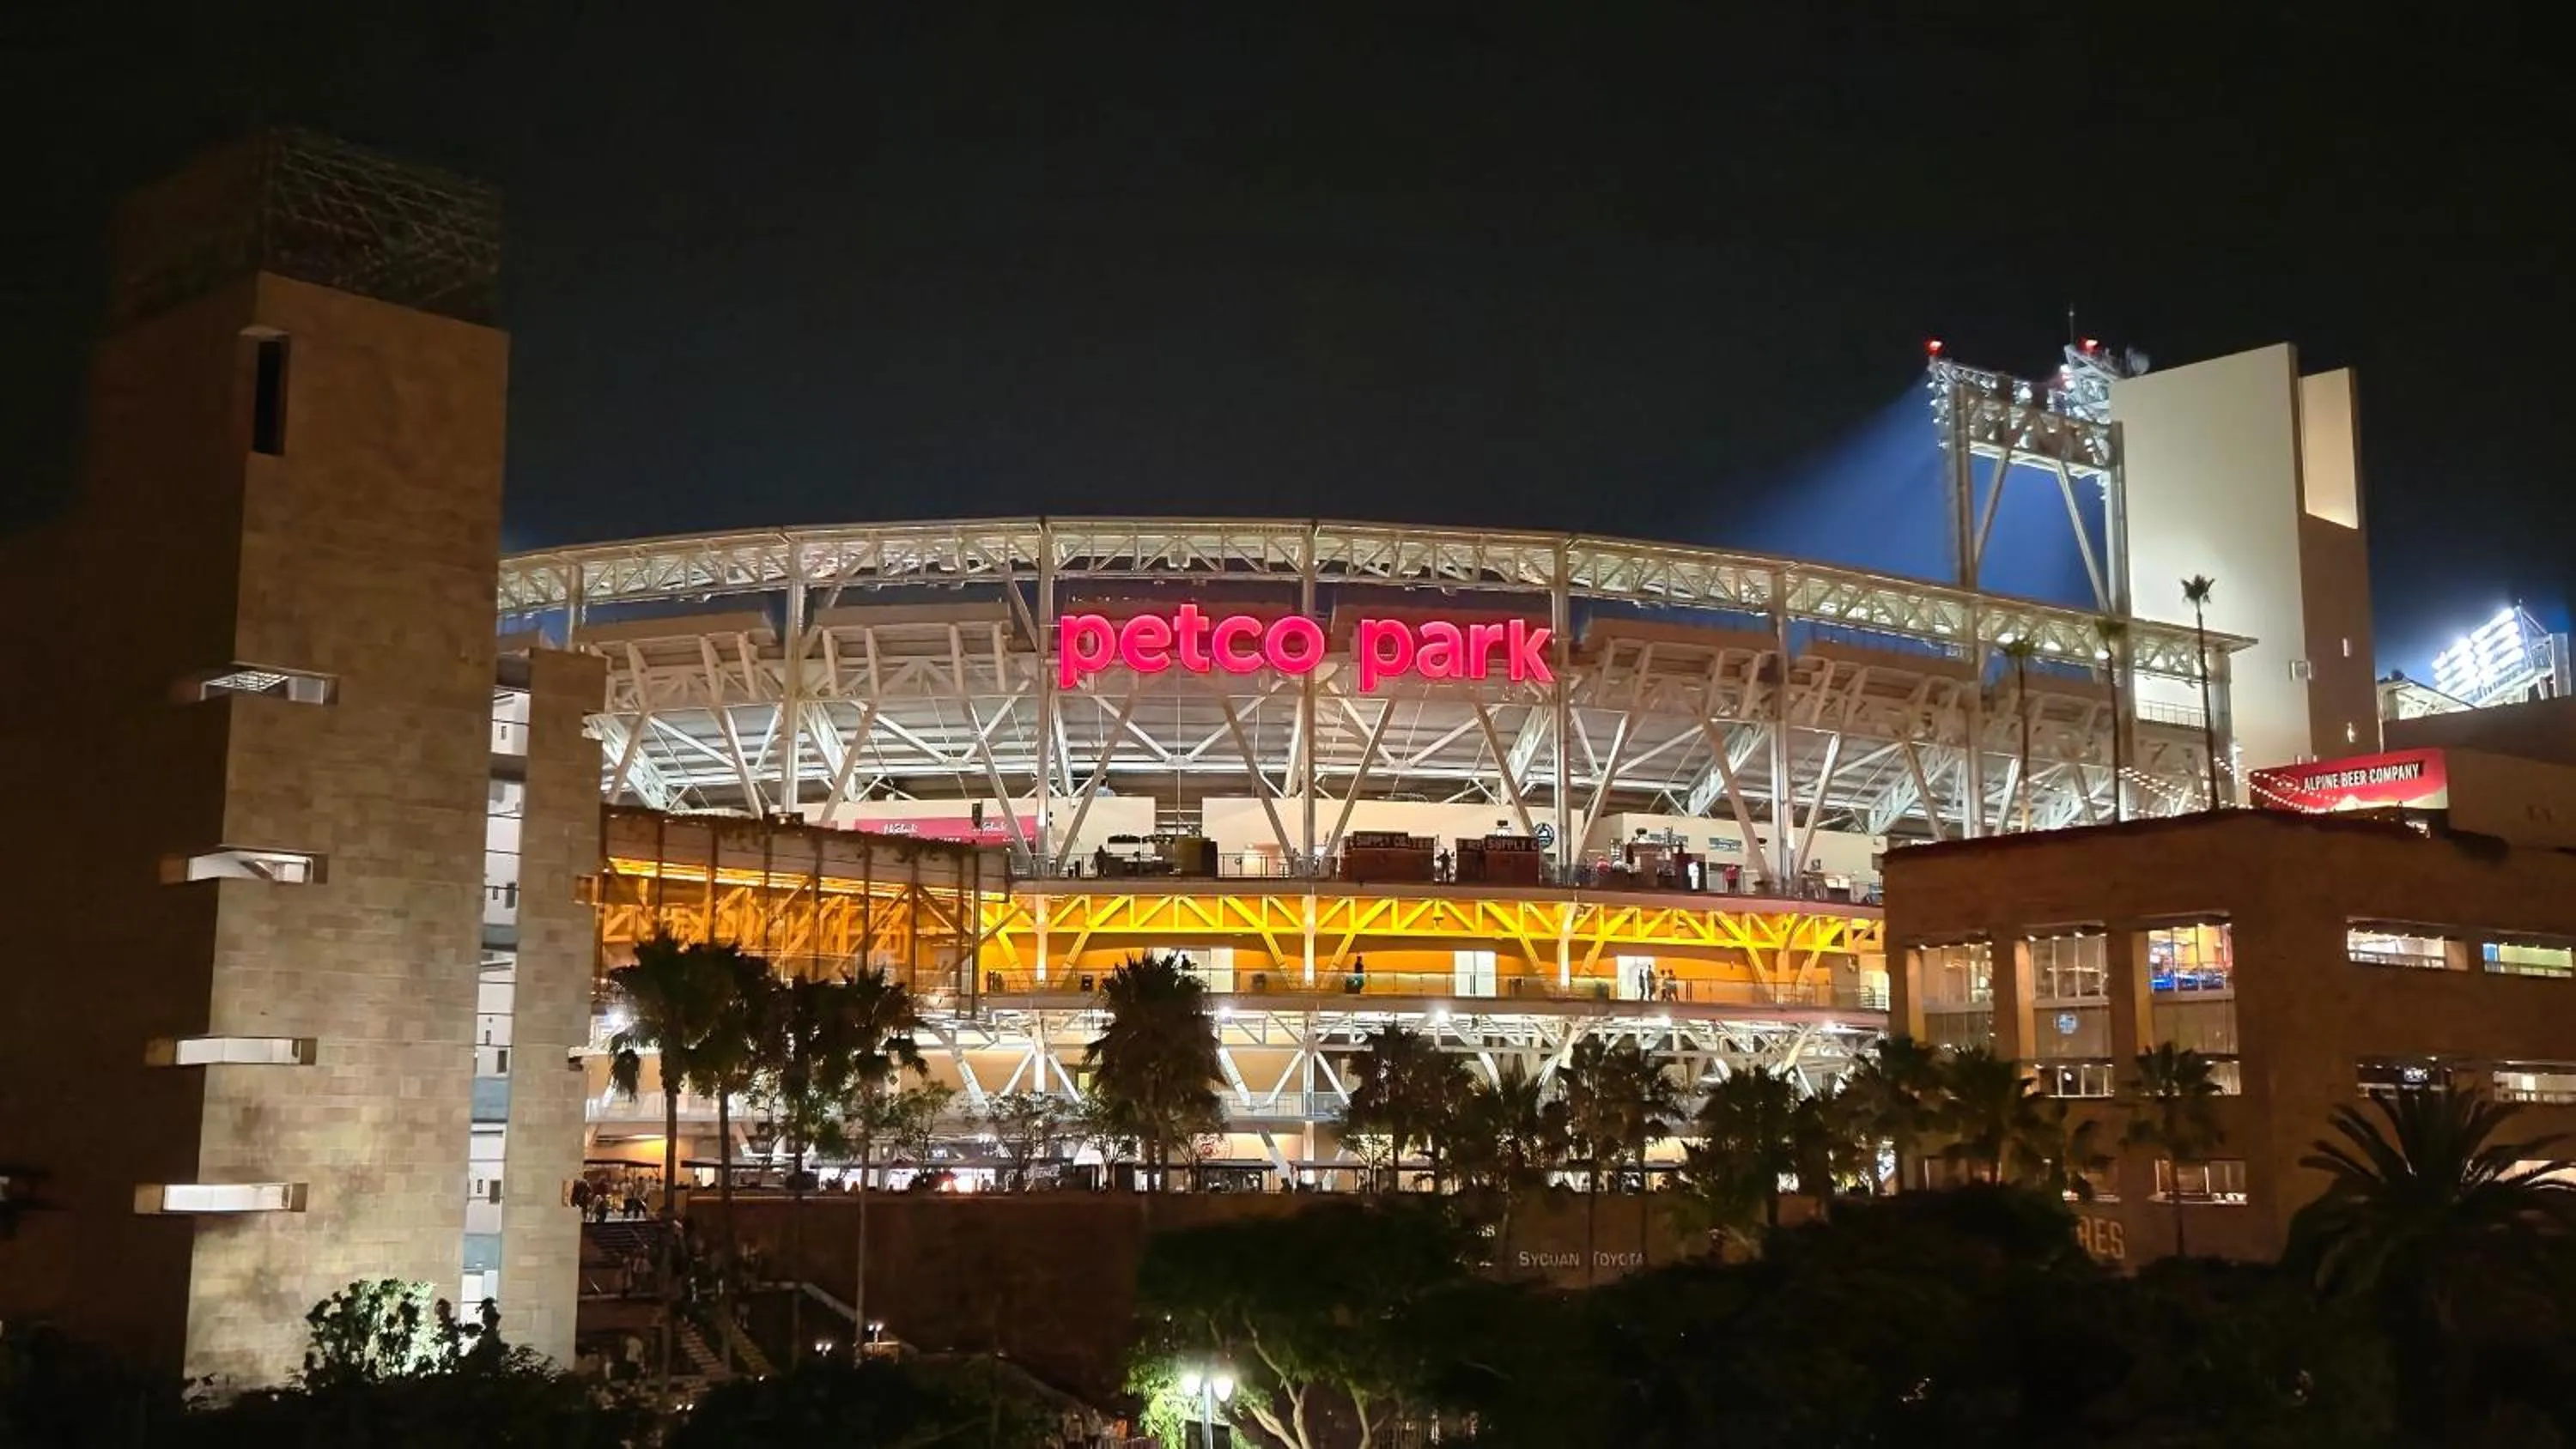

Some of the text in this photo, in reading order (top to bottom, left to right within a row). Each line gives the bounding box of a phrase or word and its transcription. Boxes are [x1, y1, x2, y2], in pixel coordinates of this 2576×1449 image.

[1059, 603, 1555, 692] petco park
[2304, 762, 2420, 791] ALPINE BEER COMPANY
